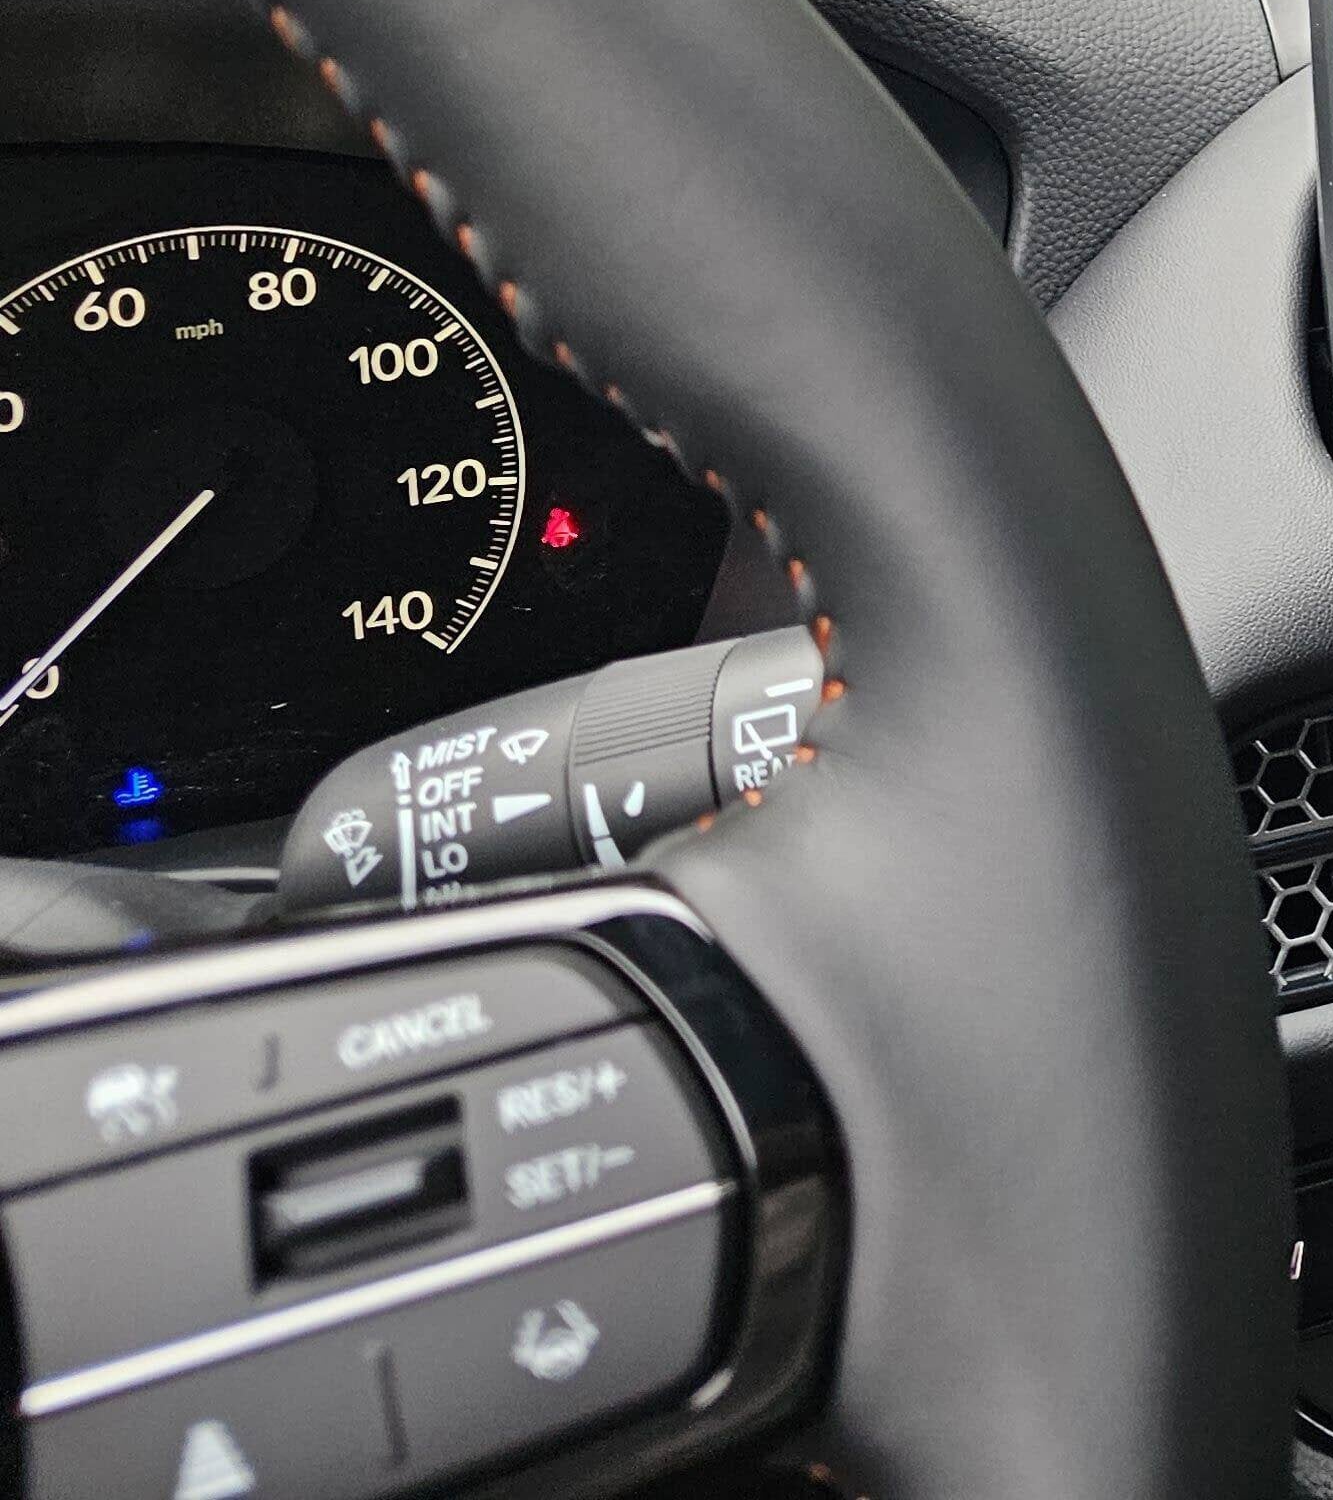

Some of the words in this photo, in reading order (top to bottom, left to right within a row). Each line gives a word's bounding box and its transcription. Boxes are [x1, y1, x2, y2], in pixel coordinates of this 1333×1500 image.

[74, 287, 145, 331] 60
[248, 268, 317, 310] 80
[175, 318, 223, 341] mph
[349, 339, 438, 384] 100
[397, 459, 487, 506] 120
[342, 591, 434, 639] 140
[417, 728, 498, 771] MIST
[417, 766, 483, 807] OFF
[420, 802, 477, 844] INT
[422, 843, 468, 878] LO
[337, 995, 493, 1069] CANCEL
